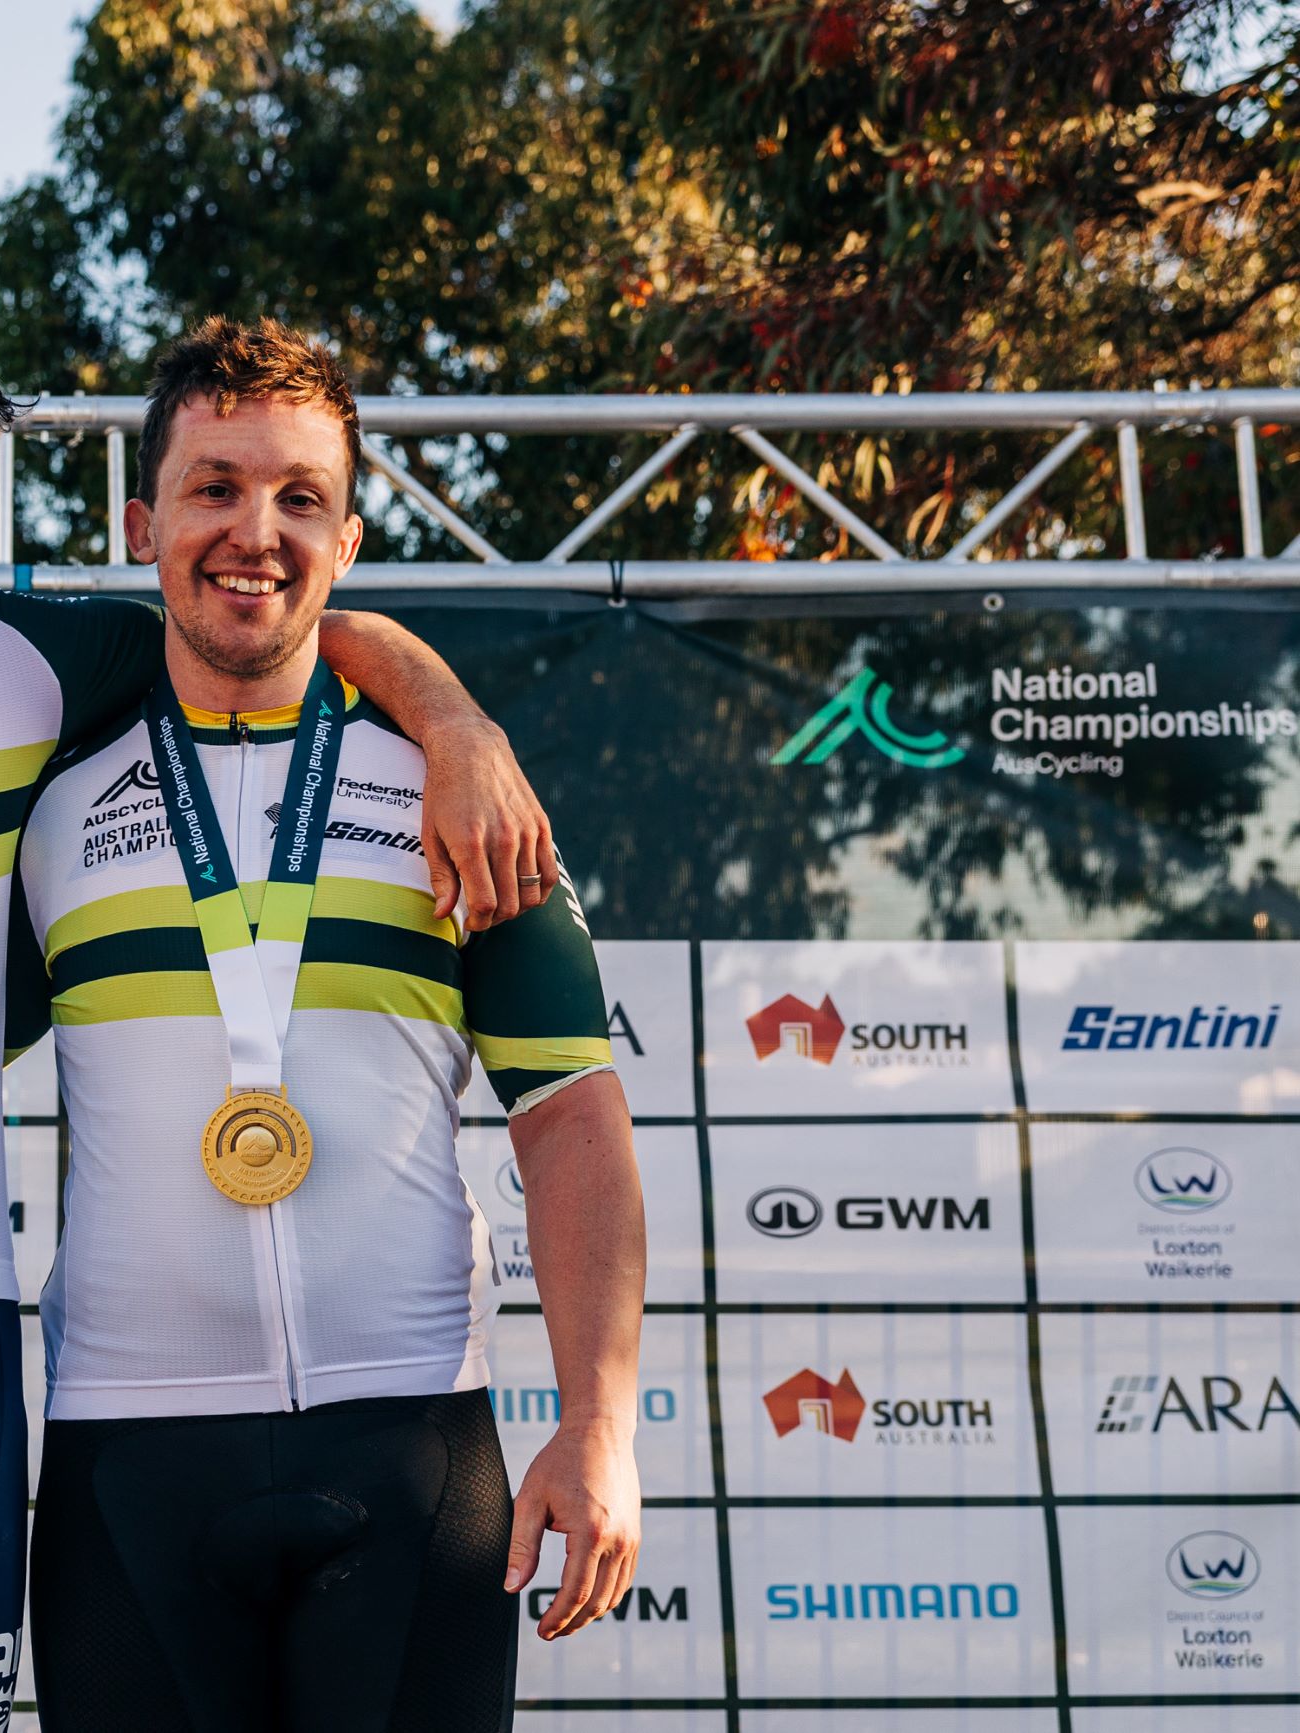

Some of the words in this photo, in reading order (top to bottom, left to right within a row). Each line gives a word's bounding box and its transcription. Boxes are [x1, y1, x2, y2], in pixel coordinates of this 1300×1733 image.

[991, 663, 1158, 701] National
[990, 701, 1299, 748] Championships
[308, 719, 333, 771] National
[159, 715, 194, 809] Championships
[992, 752, 1124, 779] AusCycling
[337, 787, 413, 809] University
[287, 771, 322, 872] Championships
[181, 809, 211, 865] National
[851, 1023, 967, 1051] SOUTH
[1062, 1005, 1280, 1050] Santini
[852, 1053, 970, 1067] AUSTRALIA
[836, 1198, 990, 1230] GWM
[1153, 1239, 1222, 1256] Loxton
[1145, 1261, 1233, 1278] Waikerie
[873, 1399, 992, 1428] SOUTH
[876, 1430, 996, 1445] AUSTRALIA
[767, 1583, 1019, 1620] SHIMANO
[1183, 1627, 1251, 1645] Loxton
[1175, 1649, 1264, 1668] Waikerie
